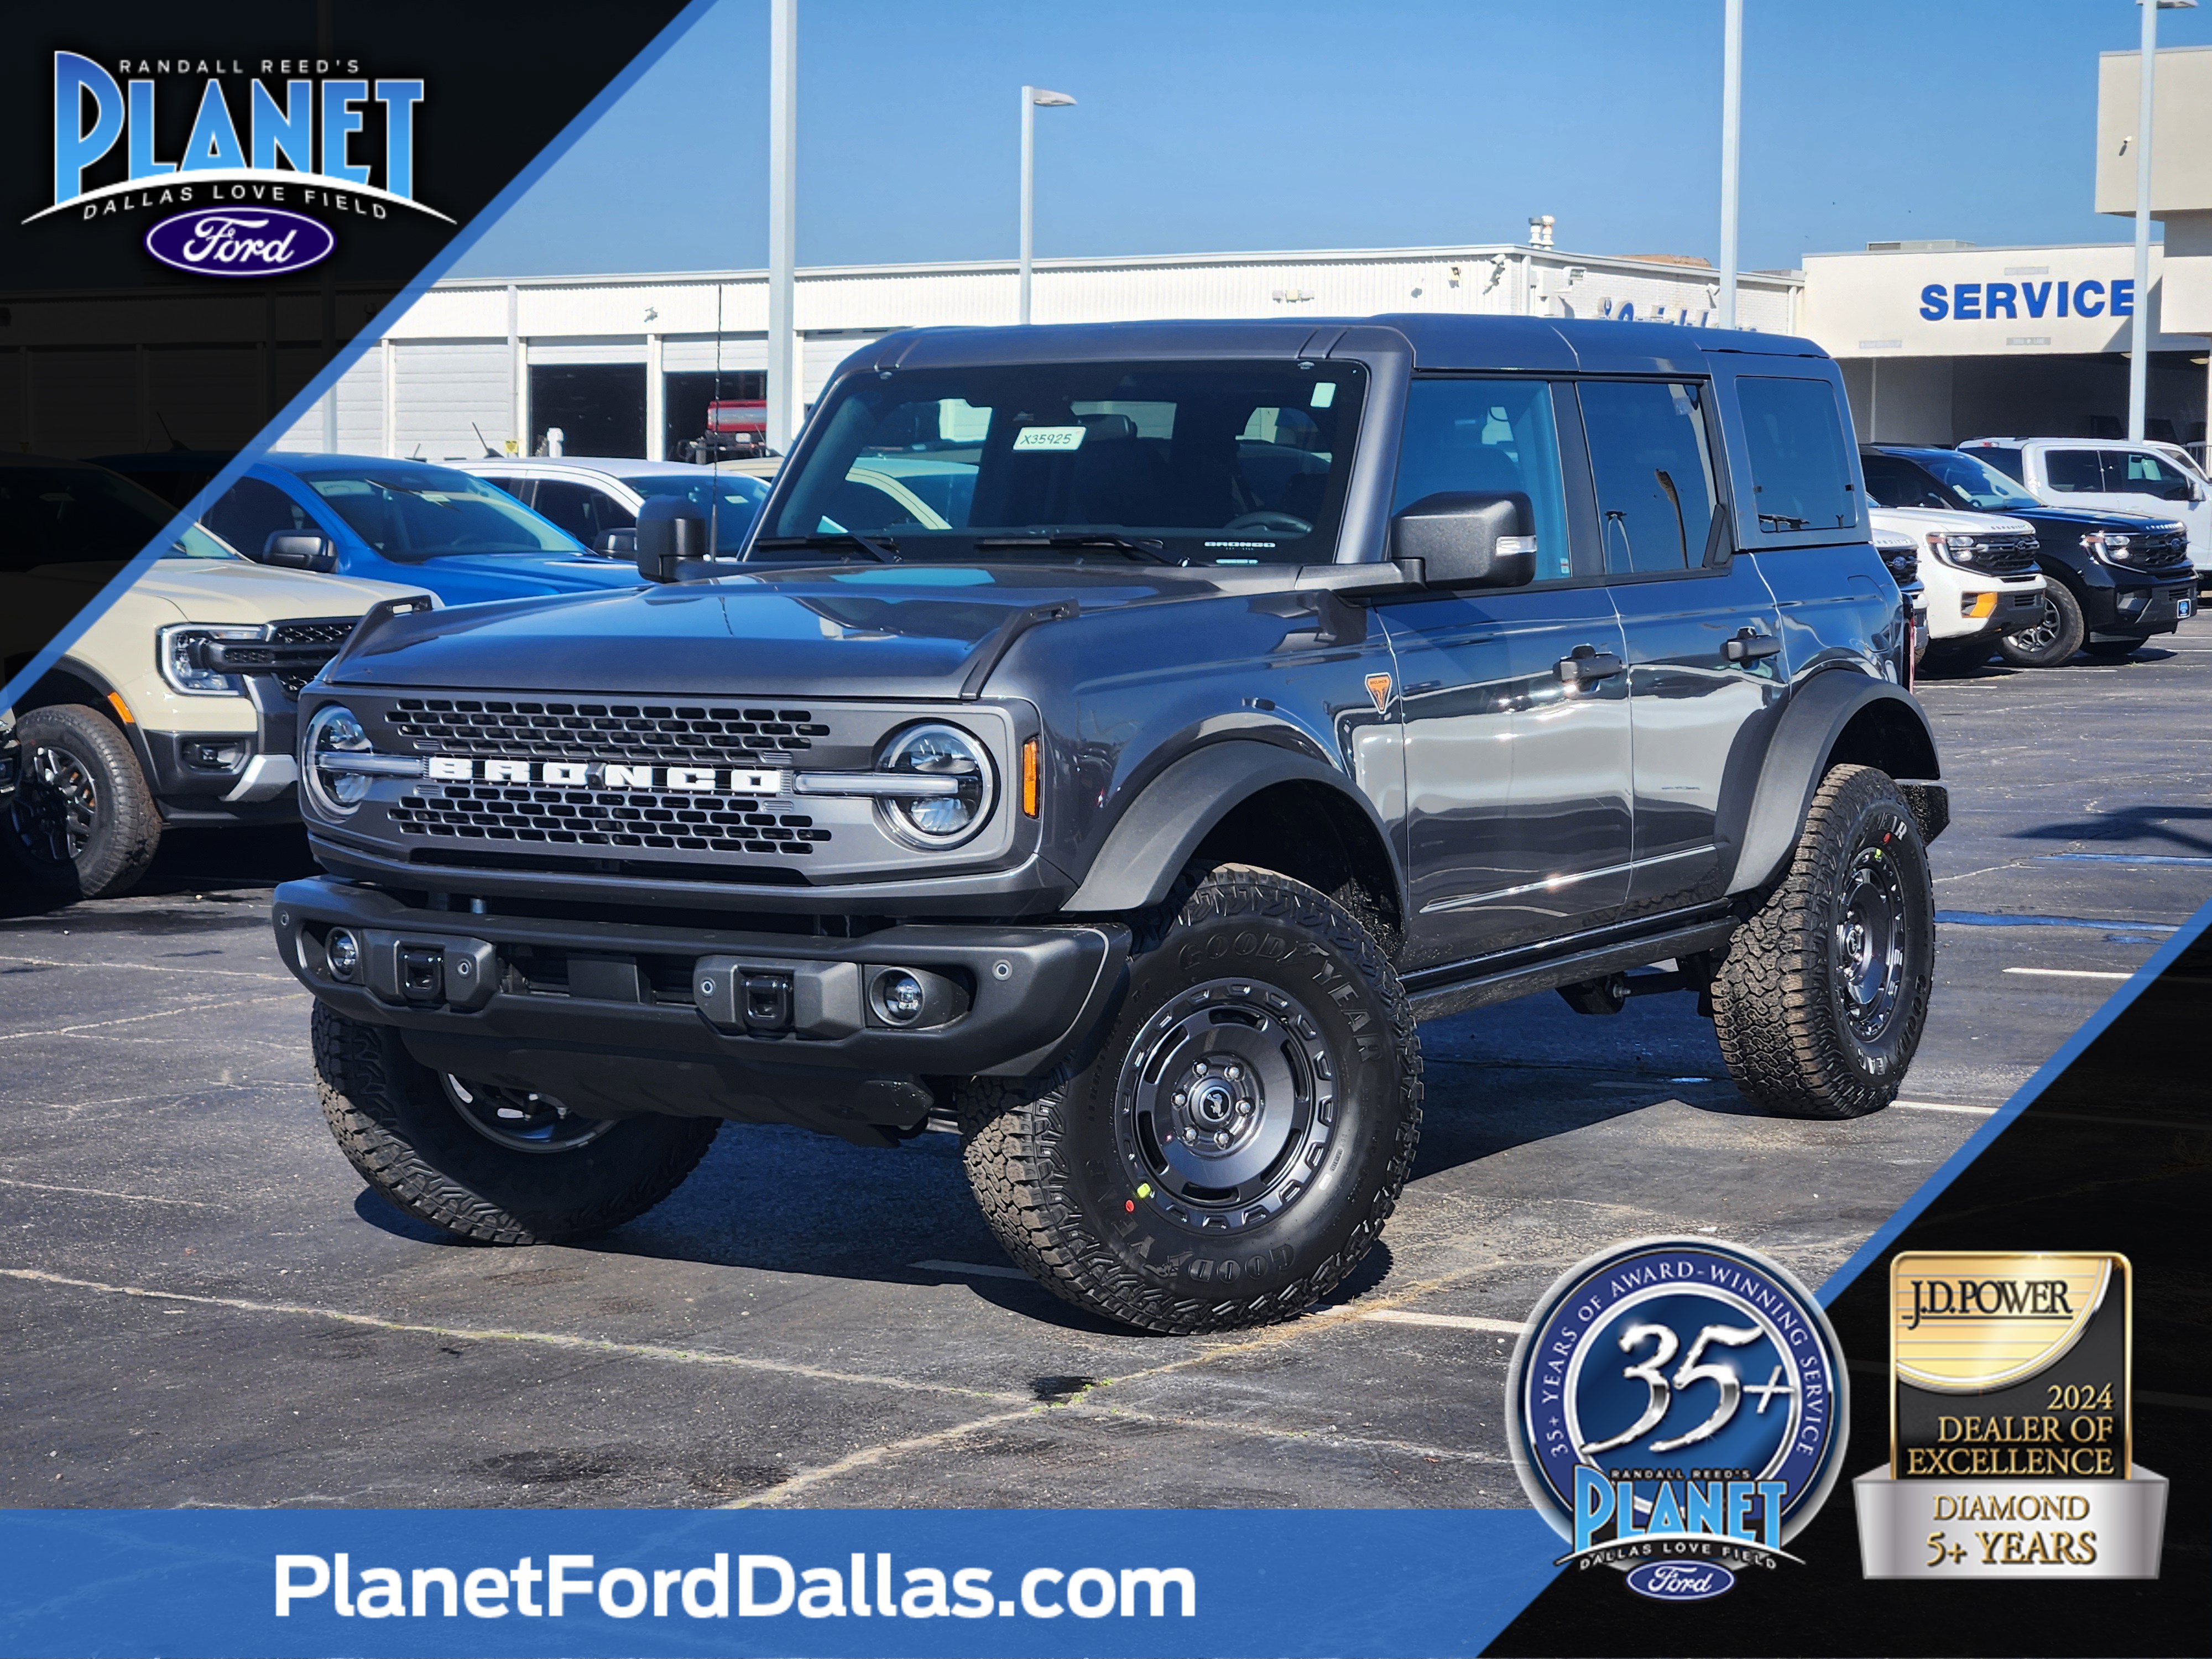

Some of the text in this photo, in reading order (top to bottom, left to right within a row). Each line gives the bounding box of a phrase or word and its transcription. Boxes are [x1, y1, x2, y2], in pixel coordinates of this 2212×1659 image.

[1919, 279, 2135, 321] SERVICE
[1020, 434, 1072, 444] X35925
[429, 757, 781, 793] BRONCO
